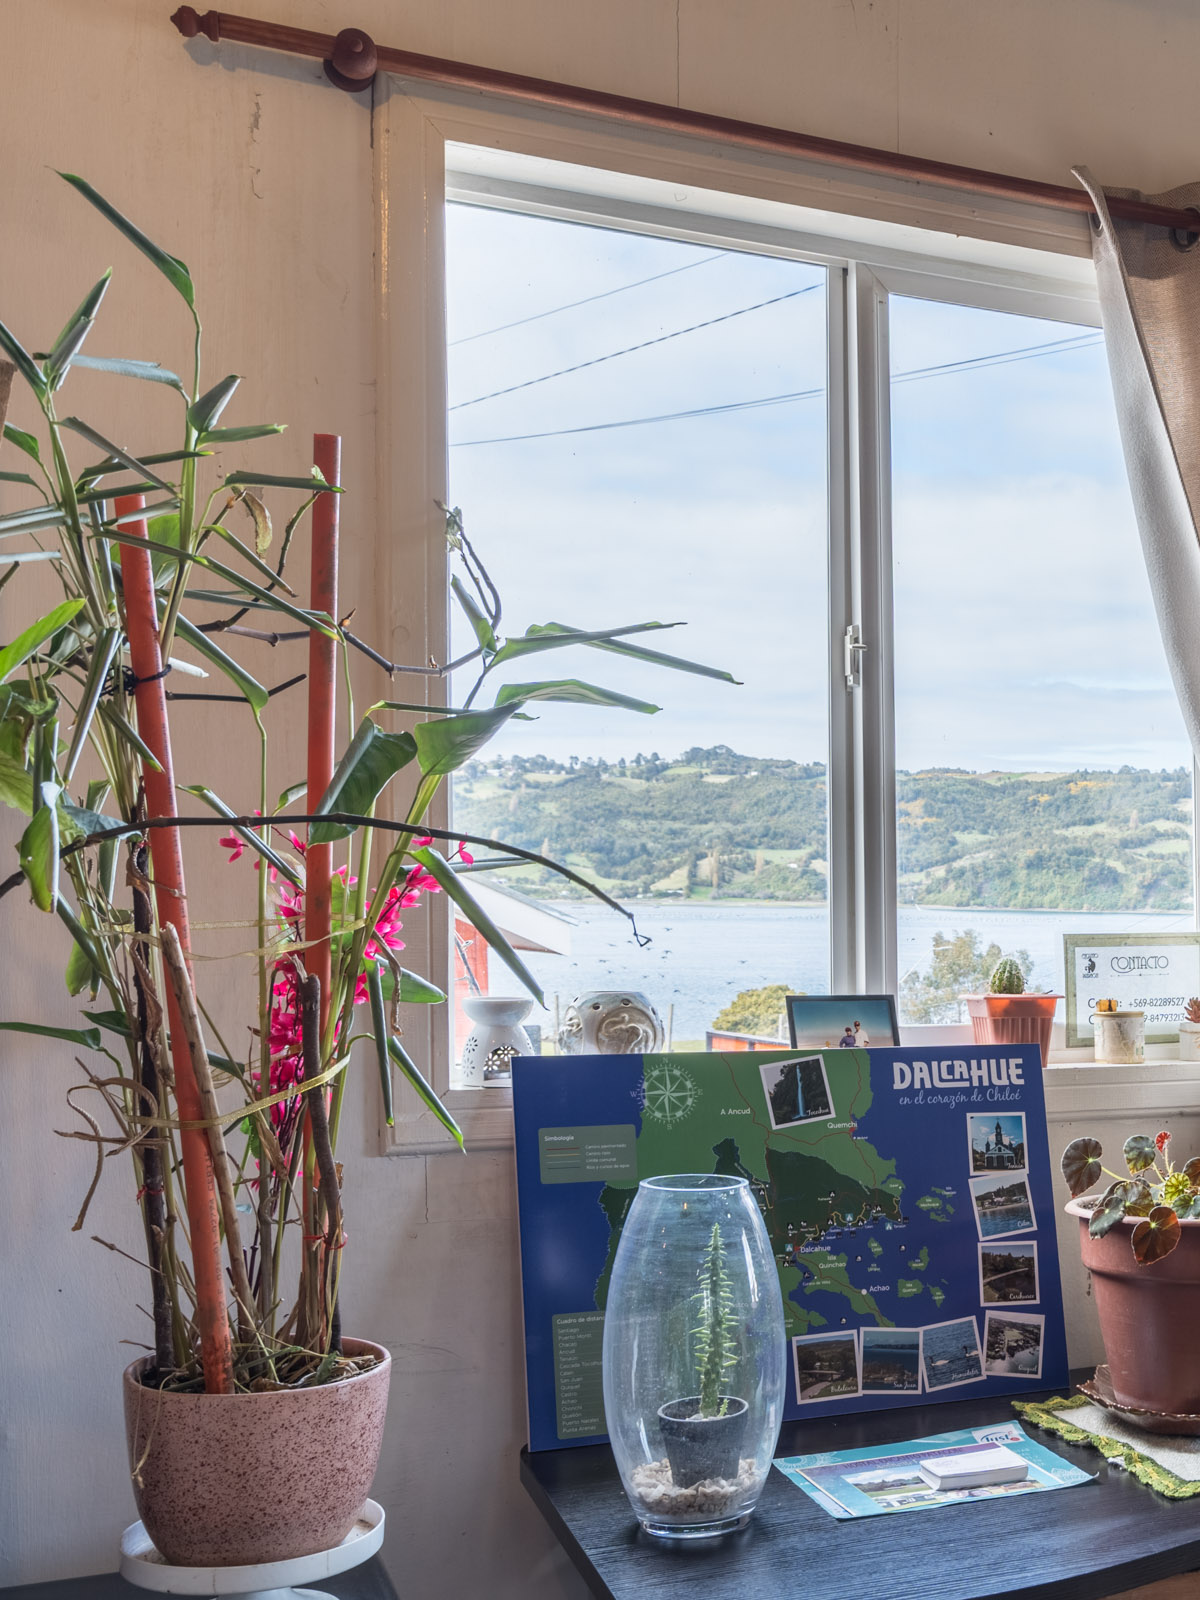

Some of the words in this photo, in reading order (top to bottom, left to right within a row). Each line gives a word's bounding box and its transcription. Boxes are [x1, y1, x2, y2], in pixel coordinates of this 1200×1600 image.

[1111, 956, 1169, 974] CONTACTO
[1128, 997, 1185, 1008] +569-82289527
[1143, 1013, 1185, 1023] 9-84793213
[893, 1058, 1025, 1090] DALCAHUE
[899, 1096, 912, 1105] en
[914, 1090, 925, 1104] el
[927, 1092, 968, 1109] corazón
[970, 1088, 984, 1102] de
[986, 1086, 1021, 1102] Chiloé
[727, 1107, 751, 1115] Ancud
[827, 1121, 857, 1129] Quemchi
[800, 1245, 831, 1253] Dalcahue
